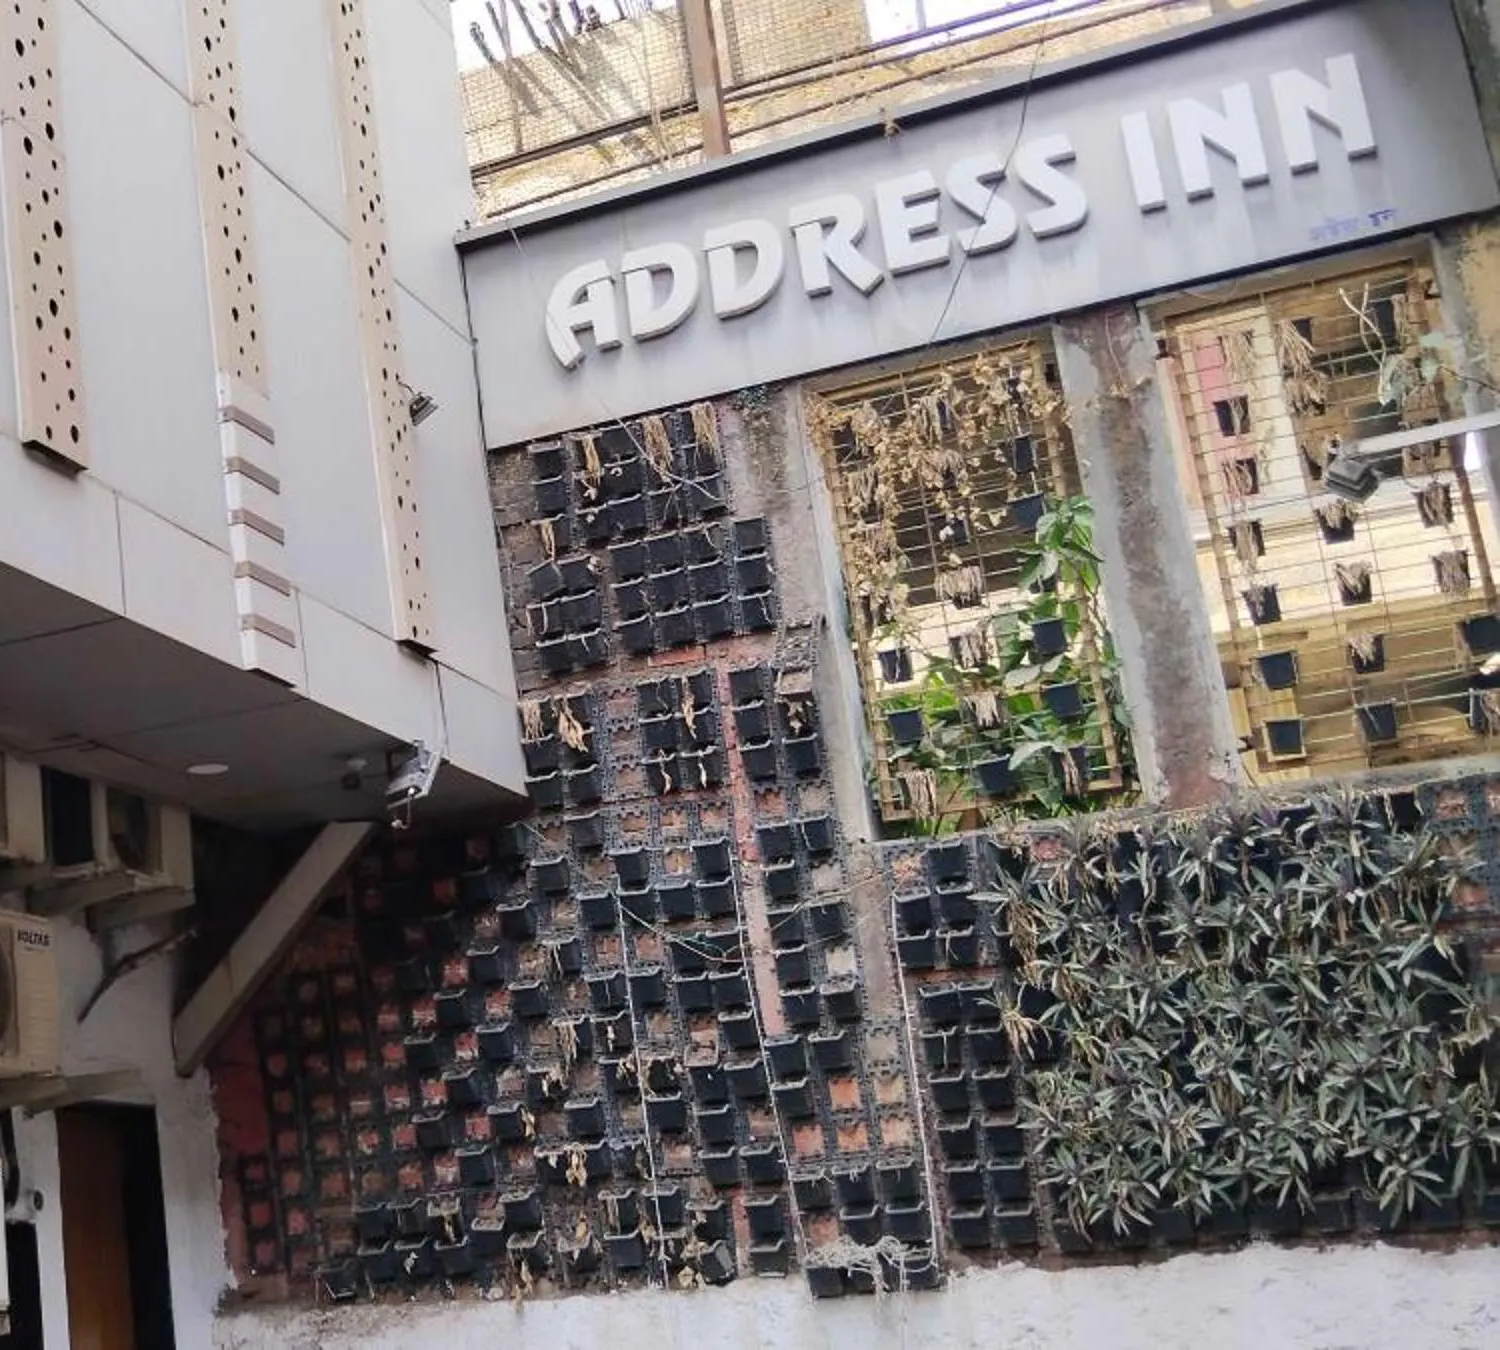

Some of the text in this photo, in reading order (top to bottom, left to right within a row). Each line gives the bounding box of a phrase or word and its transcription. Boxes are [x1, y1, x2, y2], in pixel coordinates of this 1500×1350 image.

[545, 53, 1379, 371] ADDRESS INN
[17, 929, 50, 947] VOLTAS
